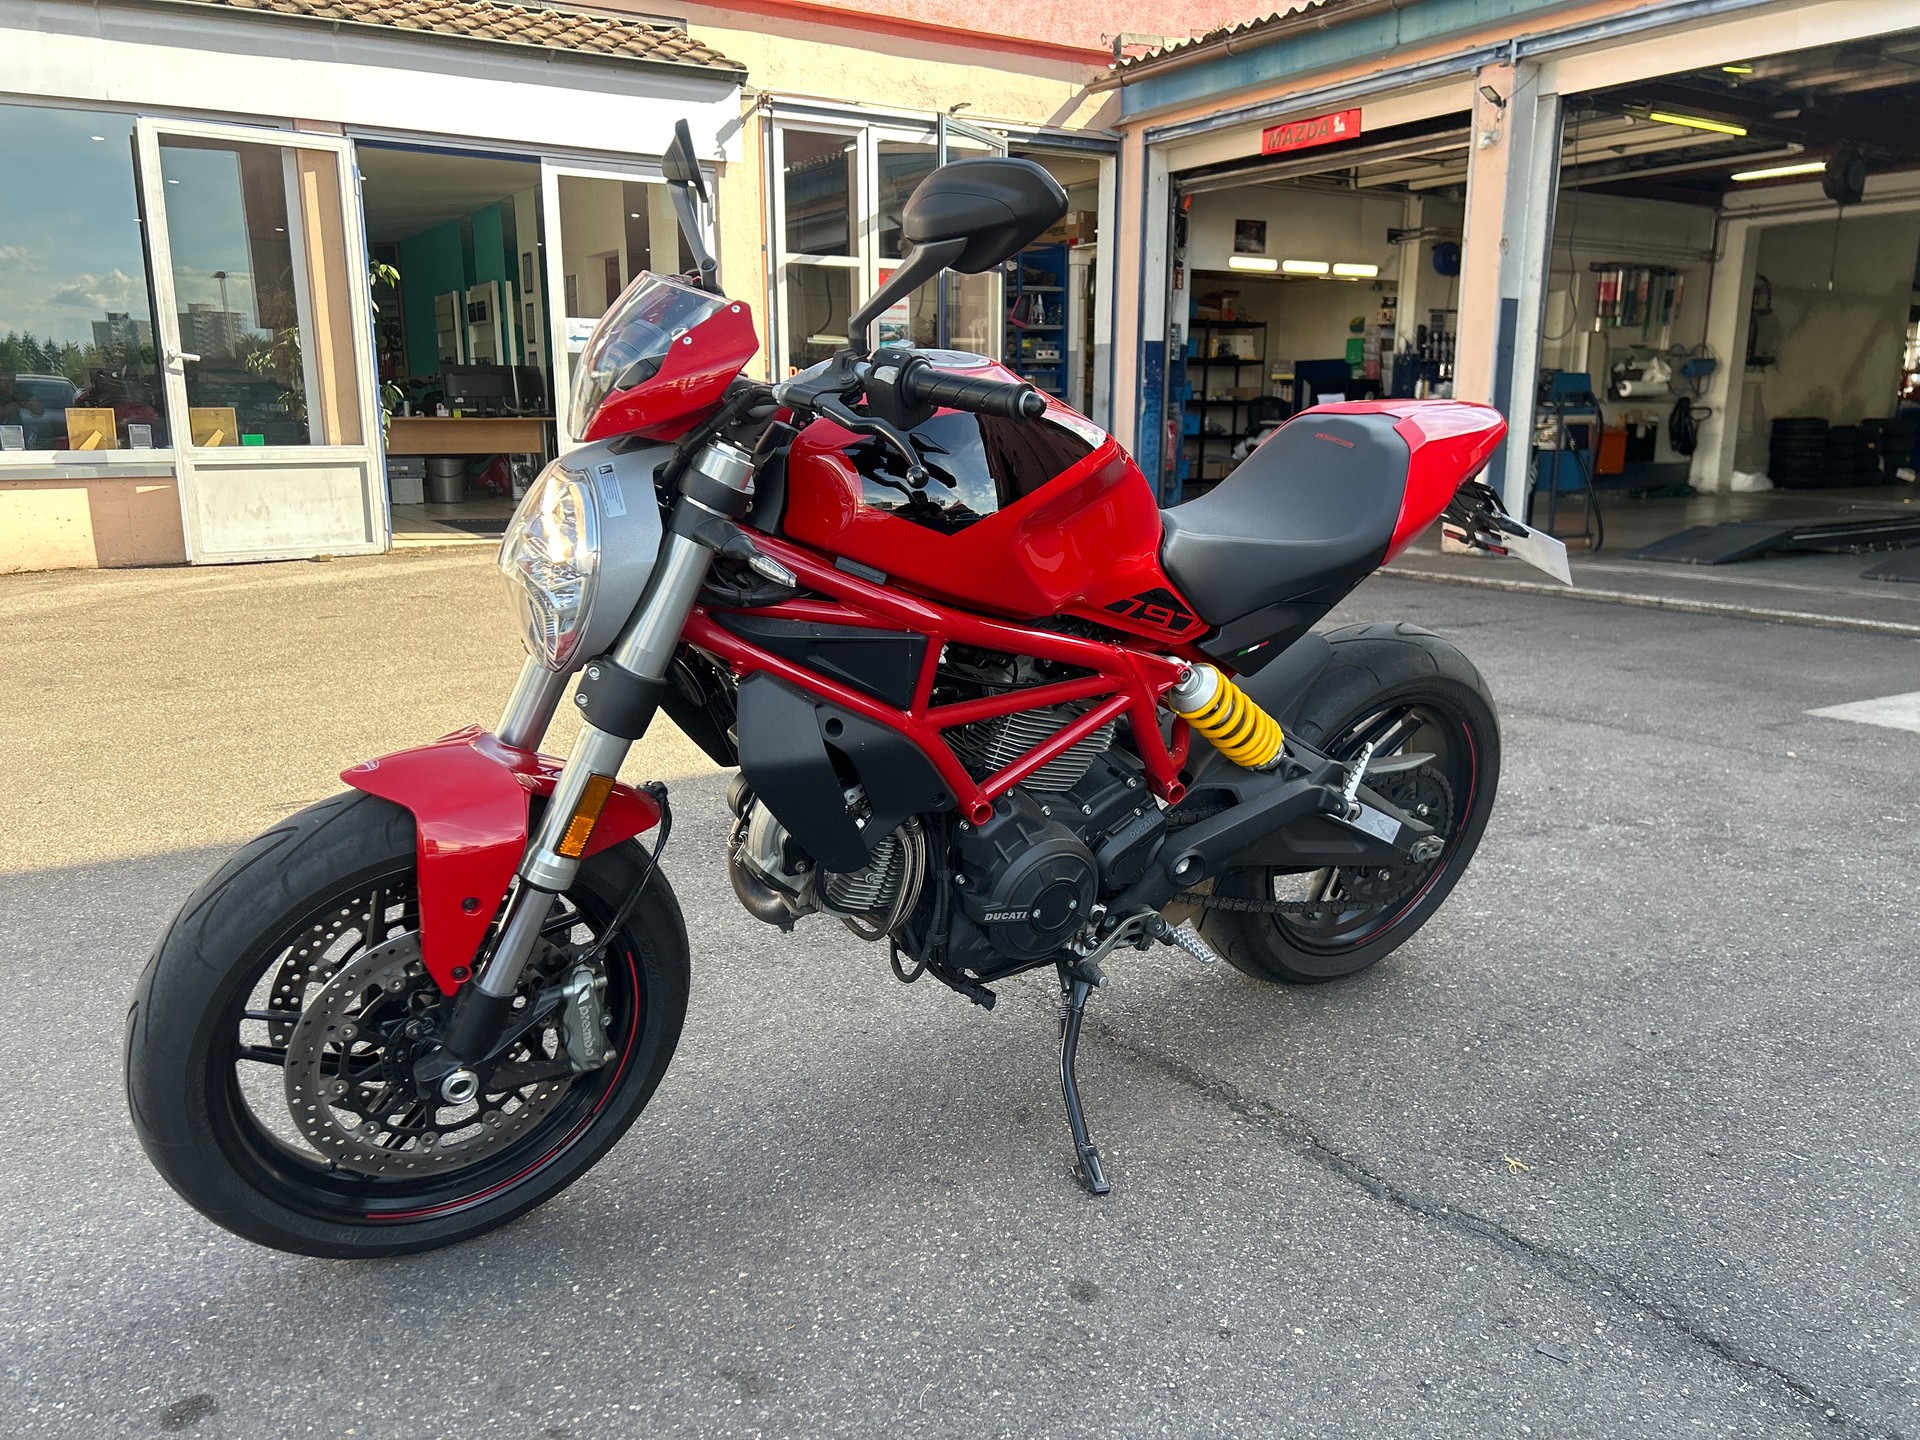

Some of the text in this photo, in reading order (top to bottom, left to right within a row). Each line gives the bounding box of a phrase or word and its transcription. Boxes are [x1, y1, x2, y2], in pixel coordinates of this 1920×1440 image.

[1267, 119, 1330, 149] MAZDA
[1119, 598, 1201, 633] 797
[1129, 816, 1156, 838] DUCATI
[984, 911, 1028, 921] DUCATI
[579, 1004, 595, 1057] brembo
